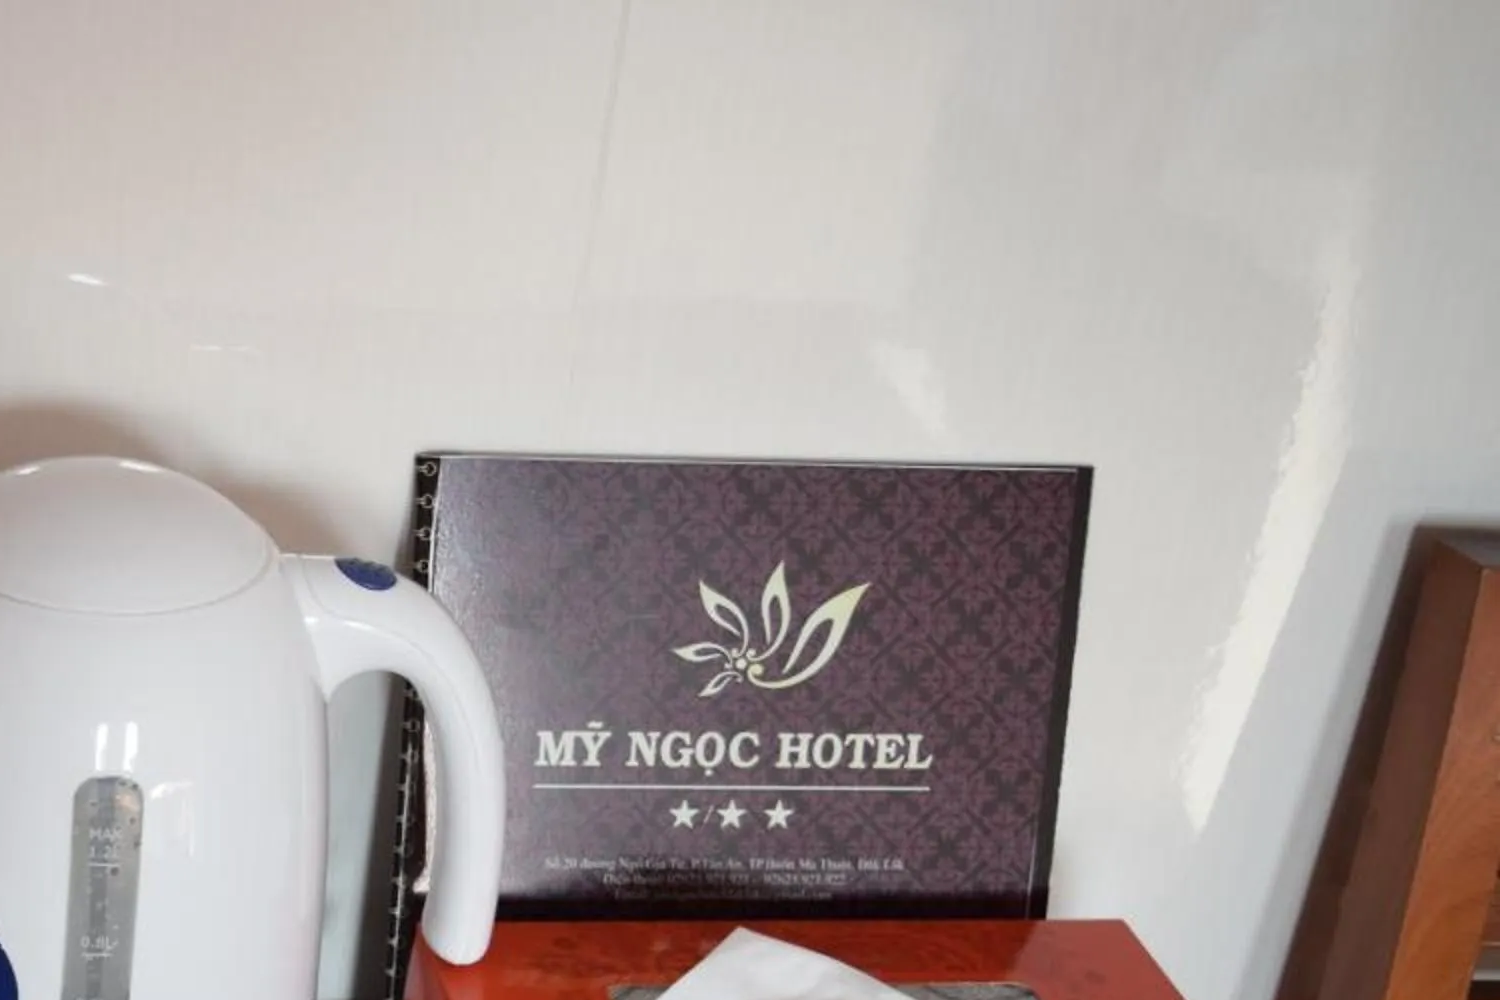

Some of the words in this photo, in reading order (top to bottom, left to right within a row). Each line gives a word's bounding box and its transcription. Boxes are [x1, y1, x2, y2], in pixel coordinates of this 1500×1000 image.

[533, 721, 612, 767] MỸ
[625, 731, 760, 777] NGỌC
[775, 732, 933, 769] HOTEL
